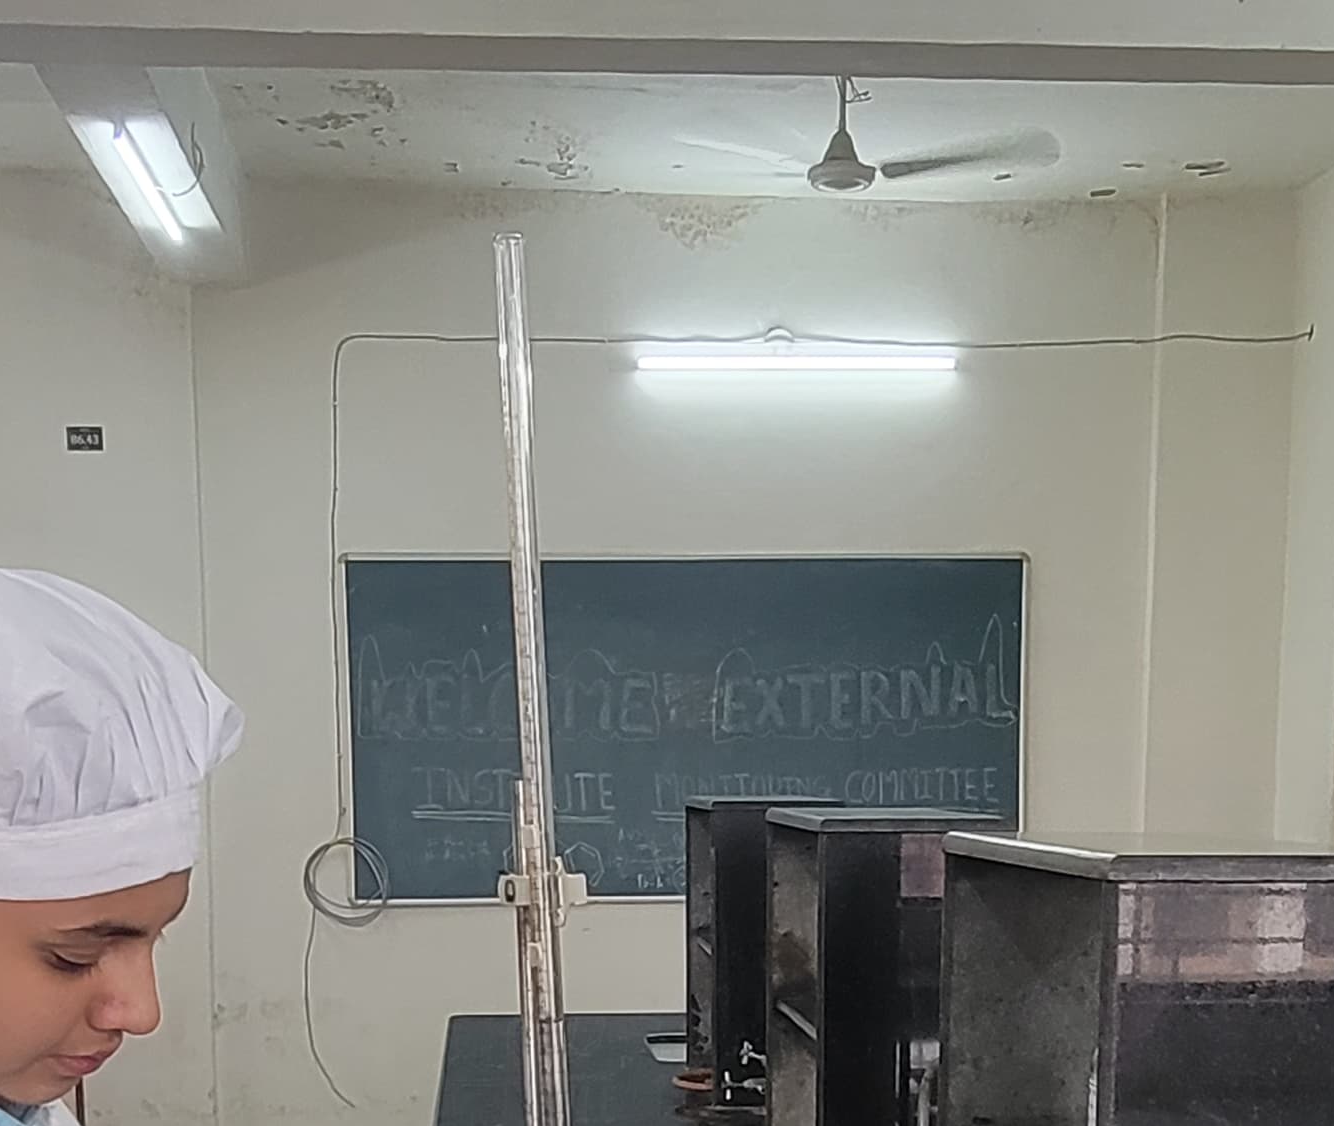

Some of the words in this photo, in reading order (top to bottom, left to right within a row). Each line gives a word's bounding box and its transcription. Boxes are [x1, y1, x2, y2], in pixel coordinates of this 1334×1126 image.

[368, 671, 653, 733] WELCME
[722, 662, 1015, 733] EXTERNAL
[412, 767, 615, 812] INSTUTE
[844, 767, 999, 805] COMMITTEE
